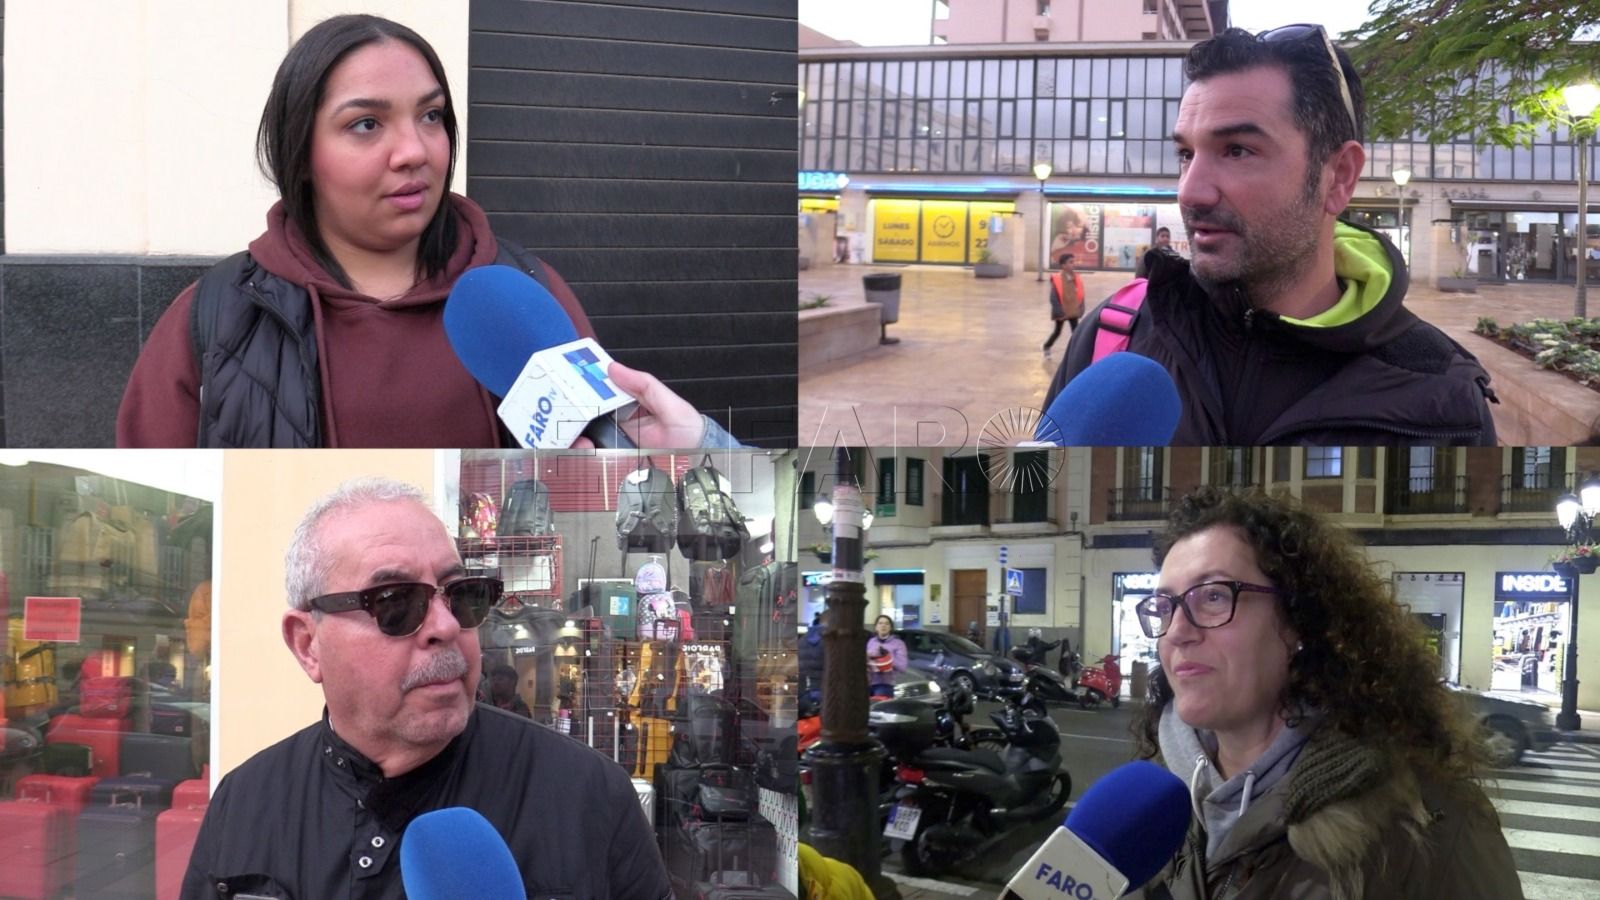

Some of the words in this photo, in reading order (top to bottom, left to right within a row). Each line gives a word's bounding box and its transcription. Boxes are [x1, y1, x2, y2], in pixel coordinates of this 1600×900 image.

[882, 222, 910, 231] LUNES
[525, 396, 553, 449] FARO
[1502, 574, 1568, 593] INSIDE
[1036, 862, 1093, 900] FARO
